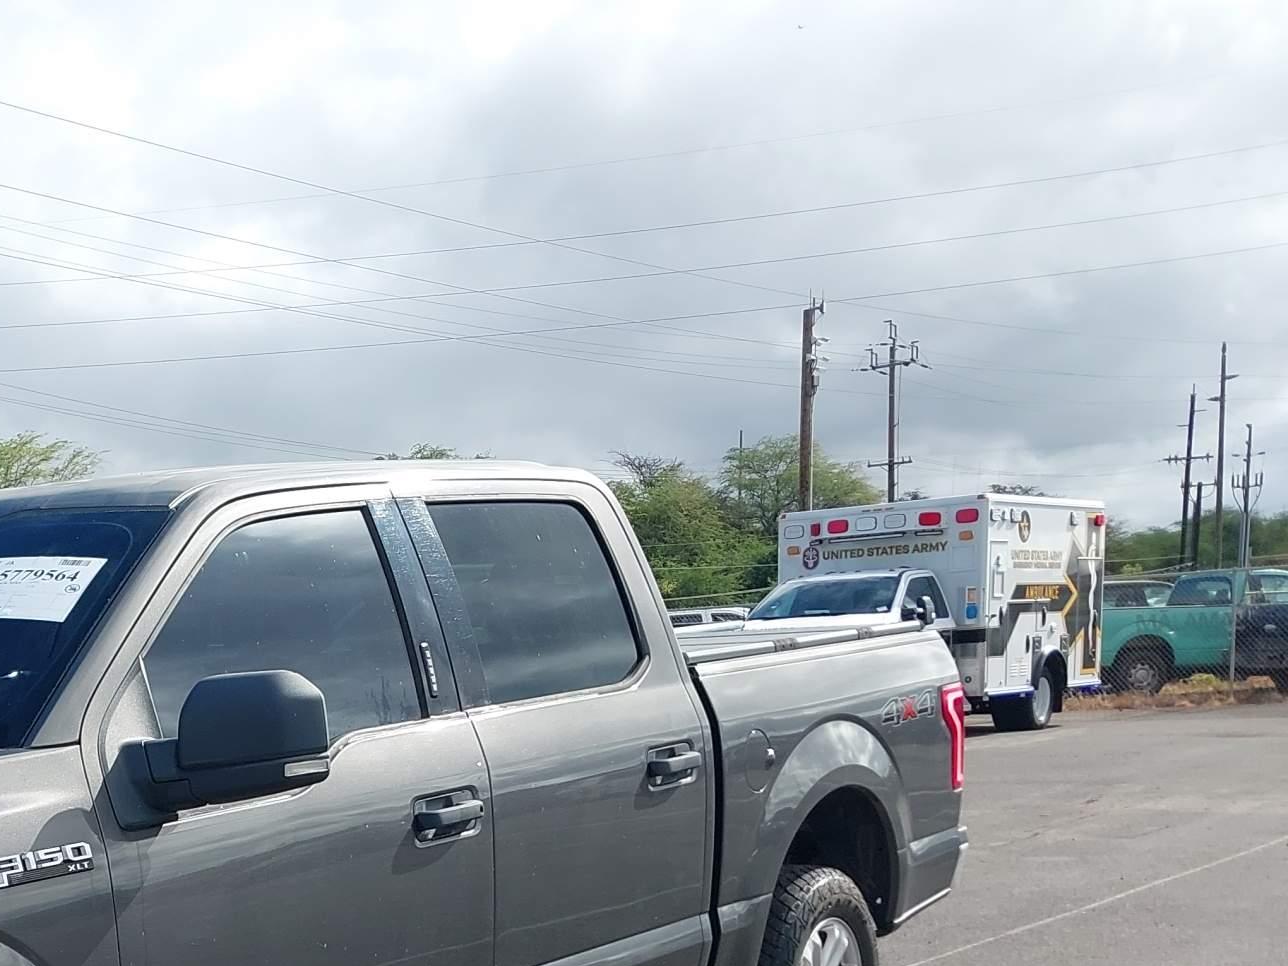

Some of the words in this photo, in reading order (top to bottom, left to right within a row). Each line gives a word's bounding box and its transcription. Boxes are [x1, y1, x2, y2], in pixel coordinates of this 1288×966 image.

[822, 547, 867, 560] UNITED
[867, 544, 910, 557] STATES
[911, 541, 949, 554] ARMY
[68, 861, 90, 873] XLT
